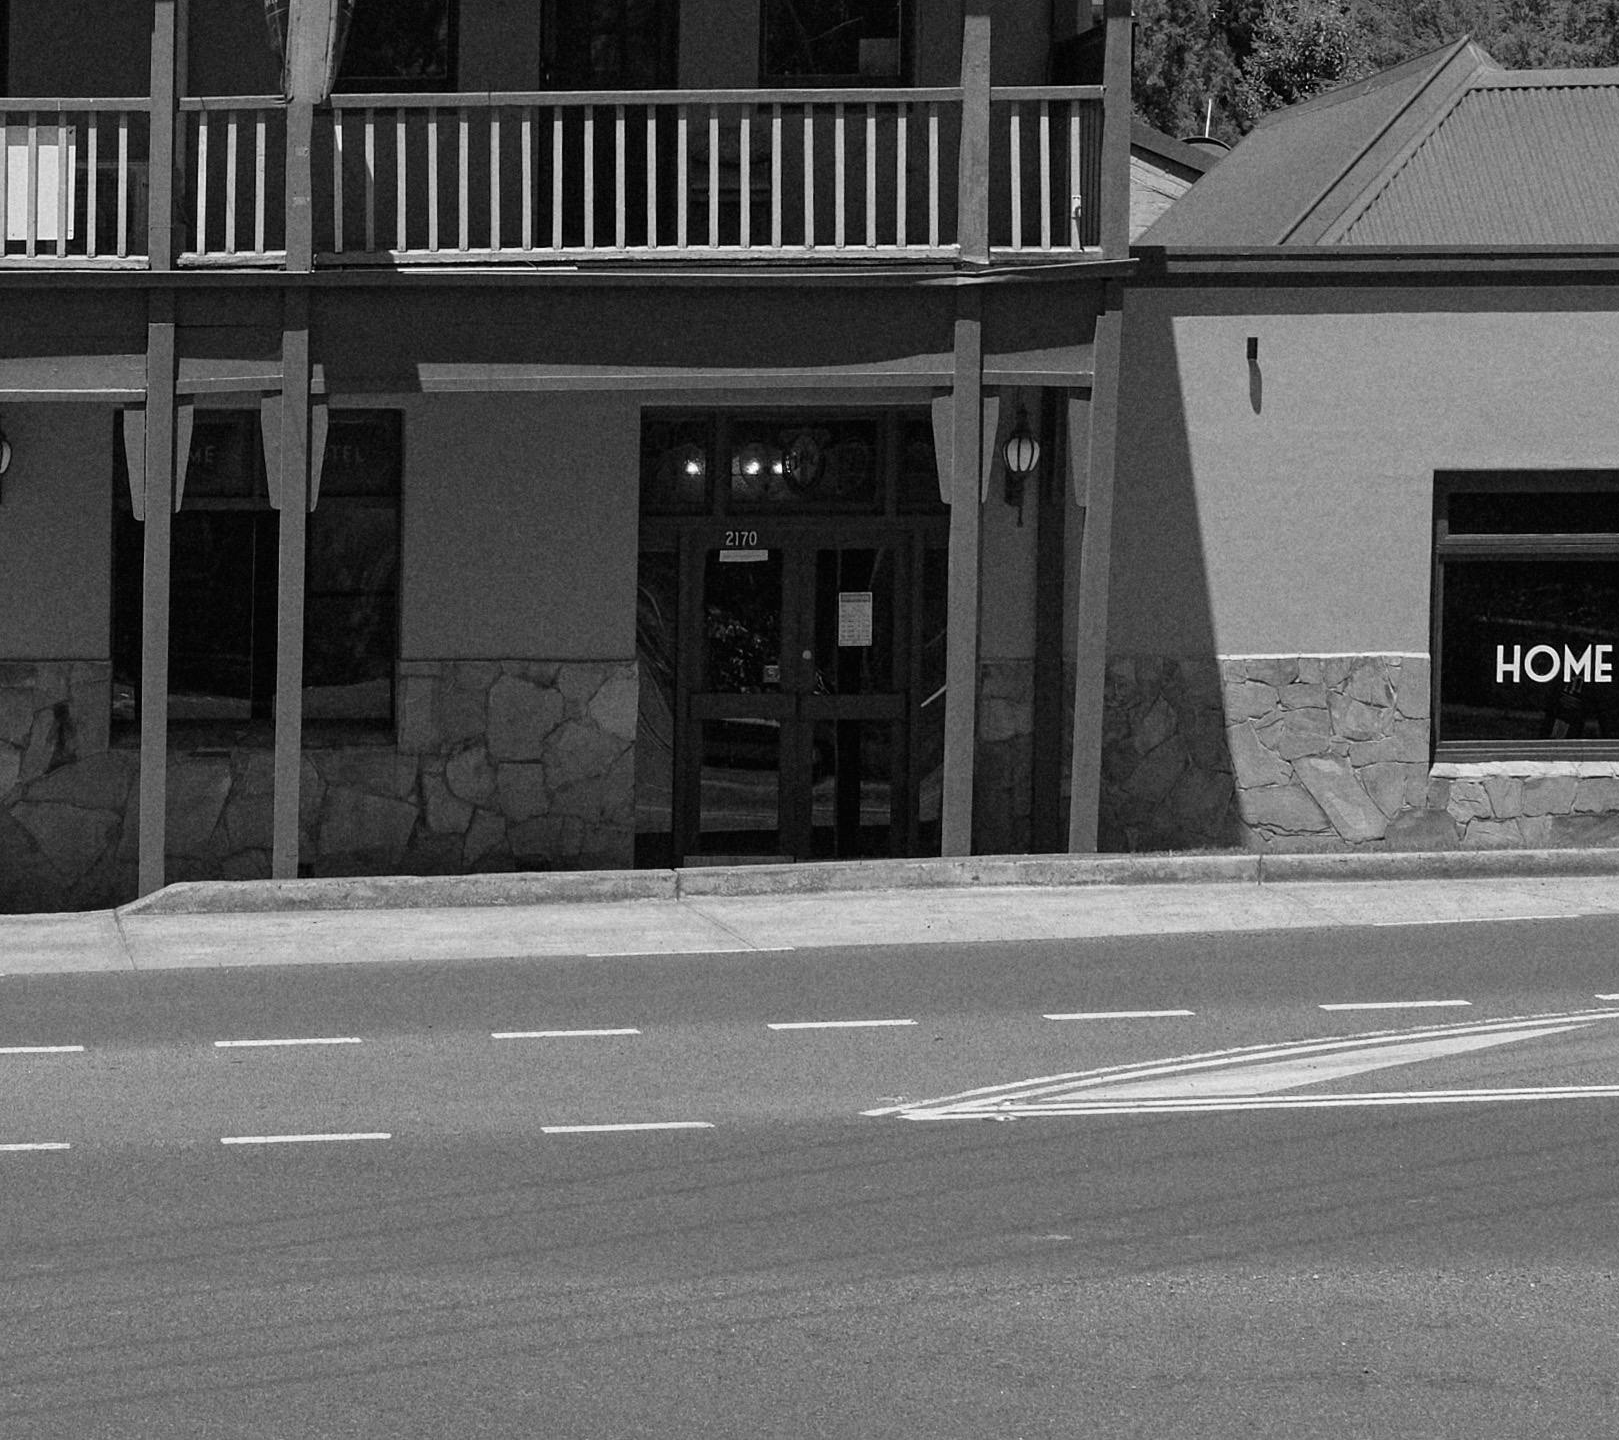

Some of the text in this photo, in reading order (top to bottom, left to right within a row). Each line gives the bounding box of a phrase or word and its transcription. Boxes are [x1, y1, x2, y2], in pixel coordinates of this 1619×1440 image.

[189, 445, 366, 465] ME TEL
[725, 531, 758, 546] 2170
[1496, 644, 1613, 683] HOME
